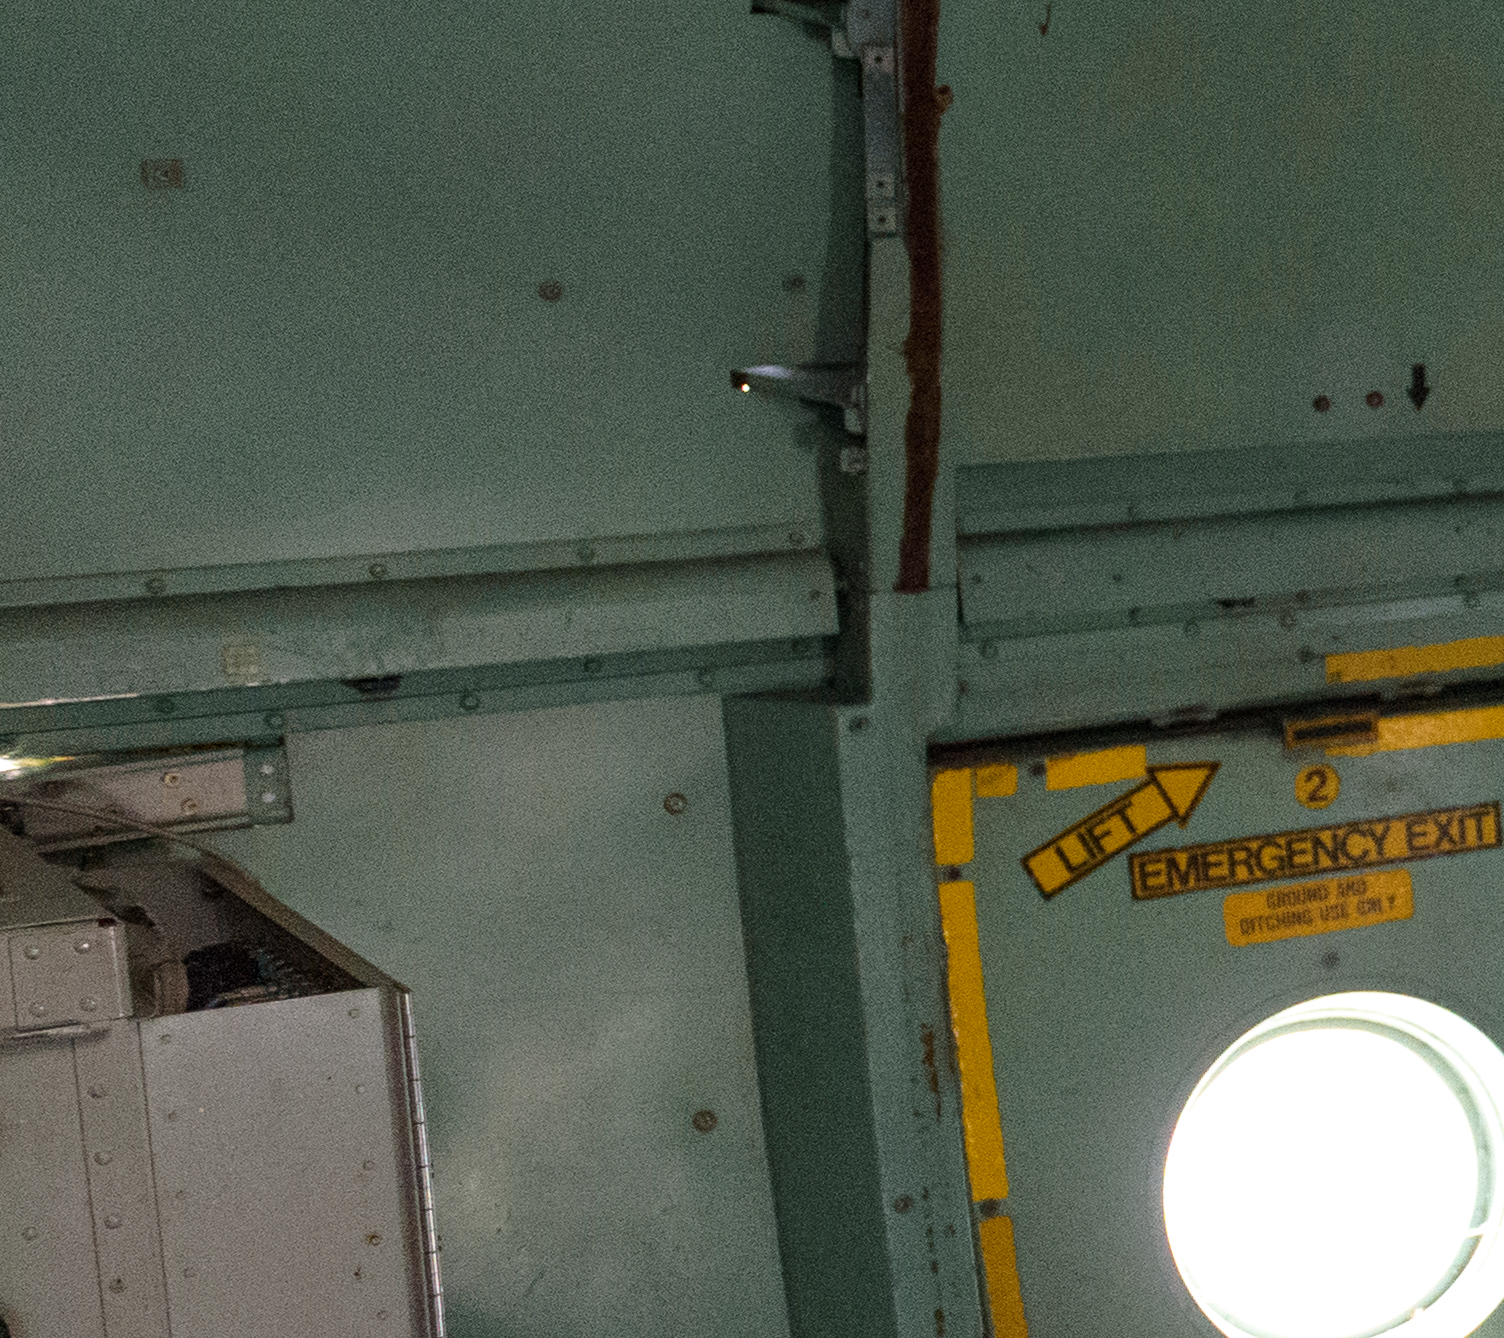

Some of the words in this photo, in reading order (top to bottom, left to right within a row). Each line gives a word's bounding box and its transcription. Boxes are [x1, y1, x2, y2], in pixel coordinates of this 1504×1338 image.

[1307, 769, 1330, 806] 2
[1055, 798, 1142, 874] LIFT
[1140, 822, 1391, 891] EMERGENCY
[1405, 808, 1491, 850] EXIT
[1266, 884, 1331, 910] GROUND
[1239, 908, 1315, 936] DITCHING
[1319, 903, 1350, 922] USE
